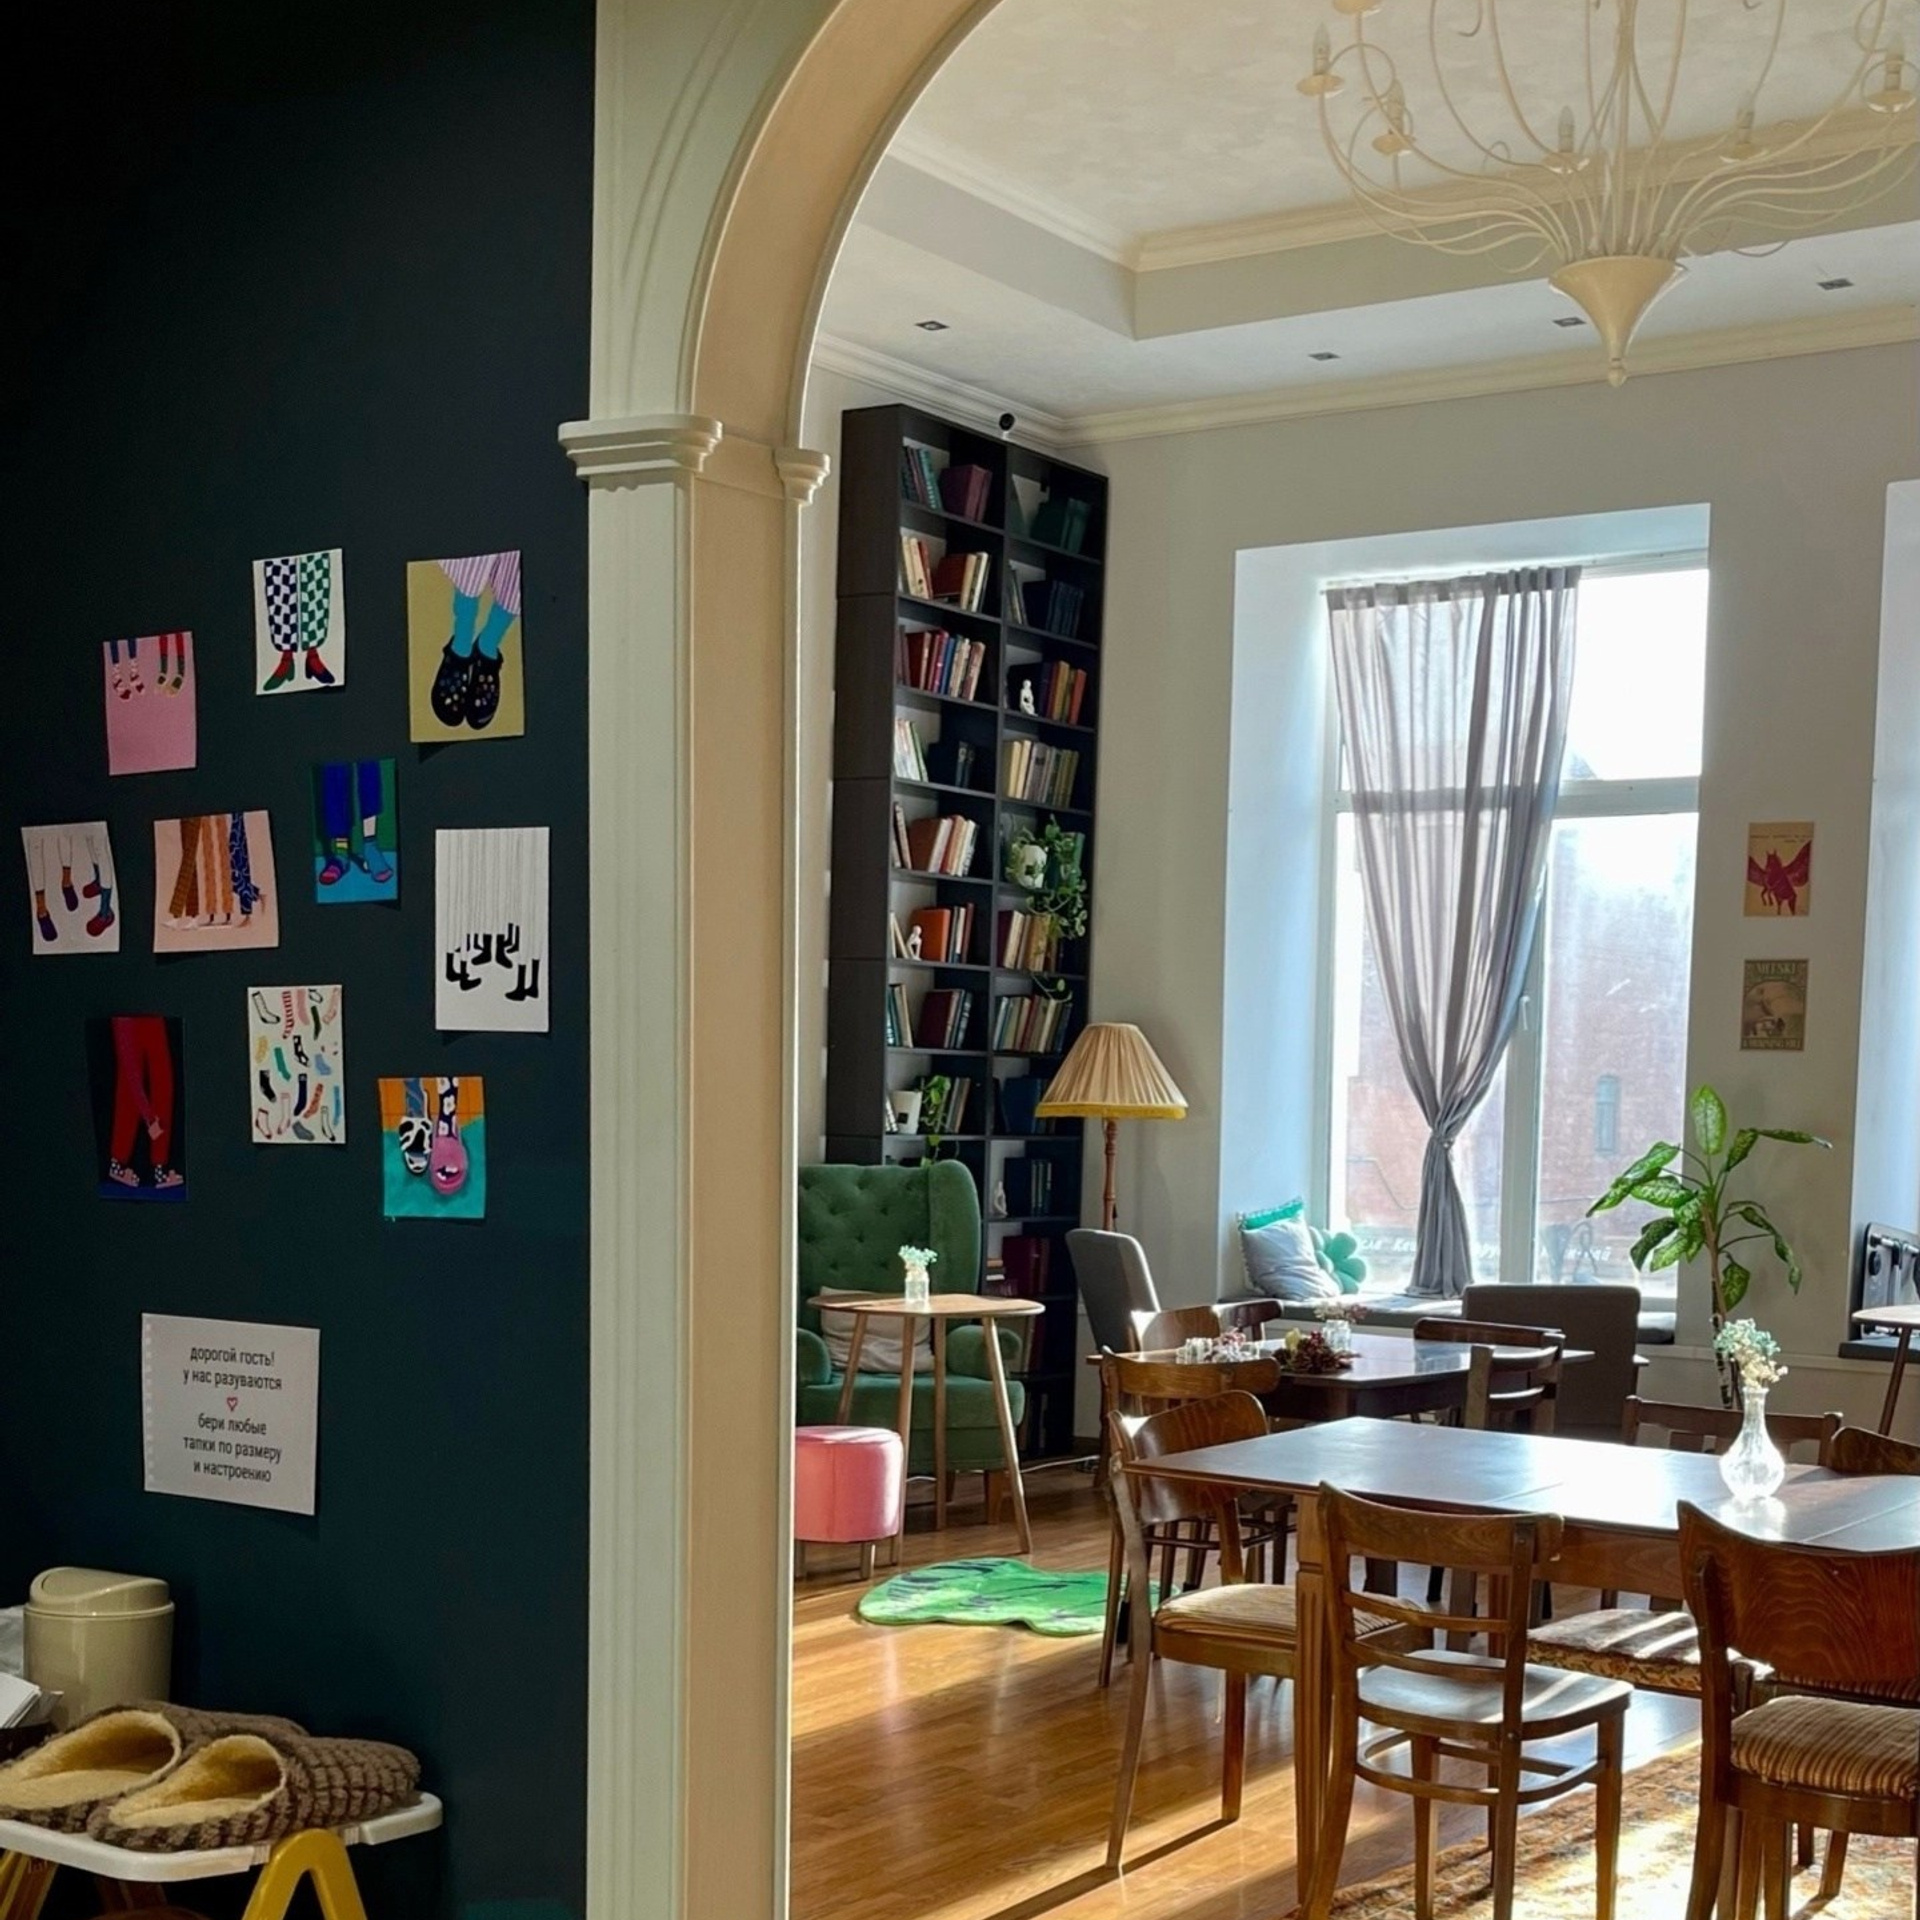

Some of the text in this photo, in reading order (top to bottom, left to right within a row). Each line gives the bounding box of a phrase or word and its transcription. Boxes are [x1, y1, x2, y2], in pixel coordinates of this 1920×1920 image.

[190, 1347, 275, 1366] дорогой гость!
[183, 1369, 282, 1390] у нас разуваются
[198, 1413, 267, 1435] бери любые
[183, 1437, 282, 1464] тапки по размеру
[193, 1461, 272, 1482] и настроению
